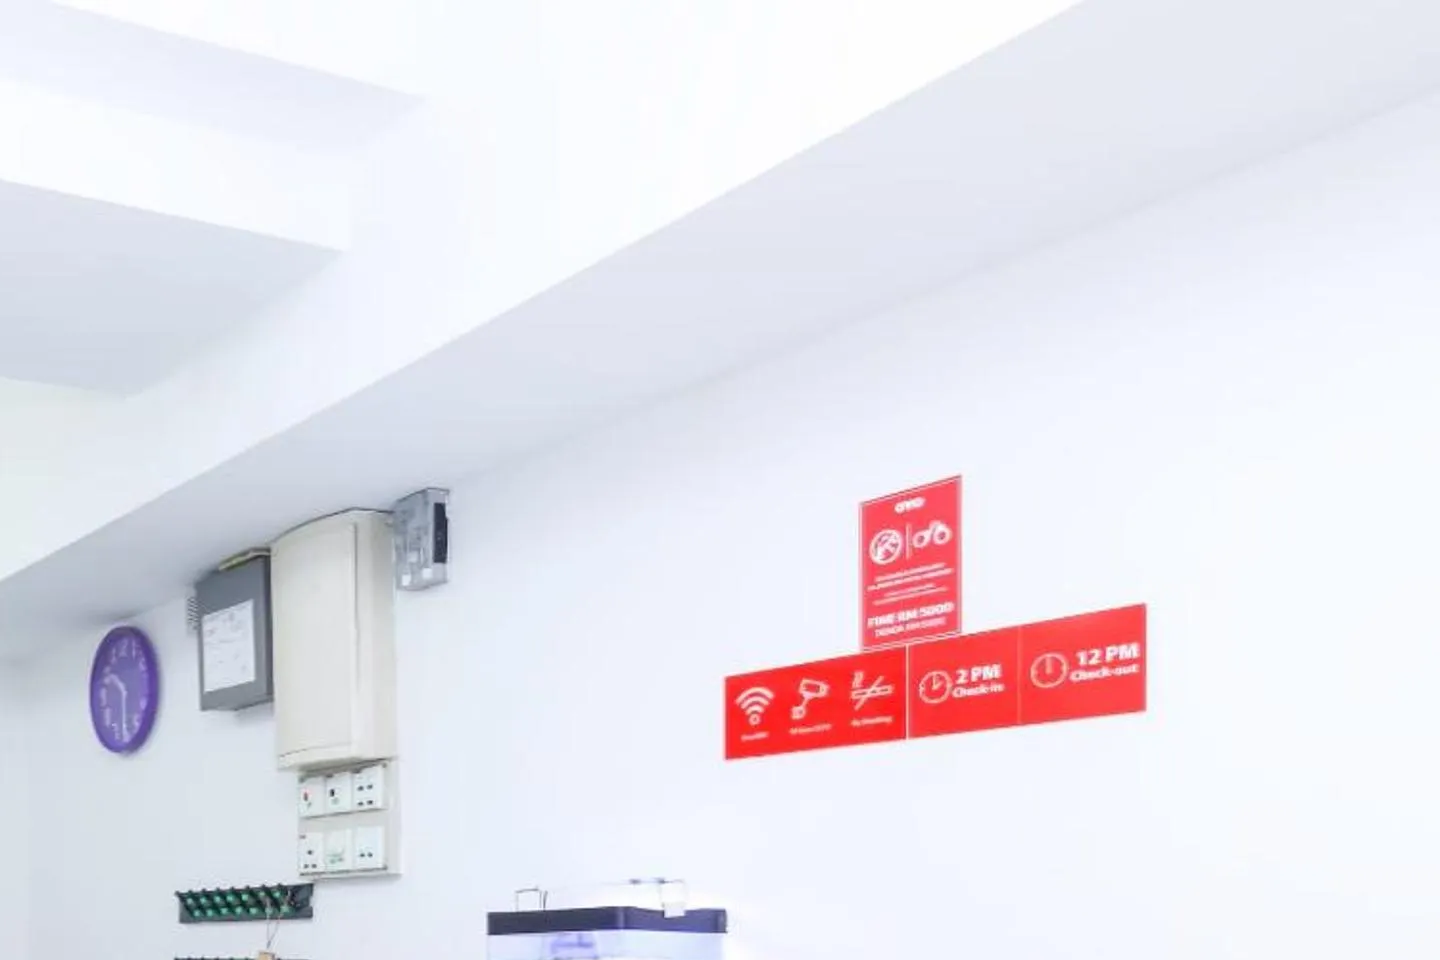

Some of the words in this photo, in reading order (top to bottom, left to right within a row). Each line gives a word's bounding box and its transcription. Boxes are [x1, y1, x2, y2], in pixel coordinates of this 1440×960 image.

[1076, 649, 1102, 666] 12
[1105, 642, 1140, 663] PM
[956, 669, 969, 685] 2
[971, 663, 1002, 682] PM
